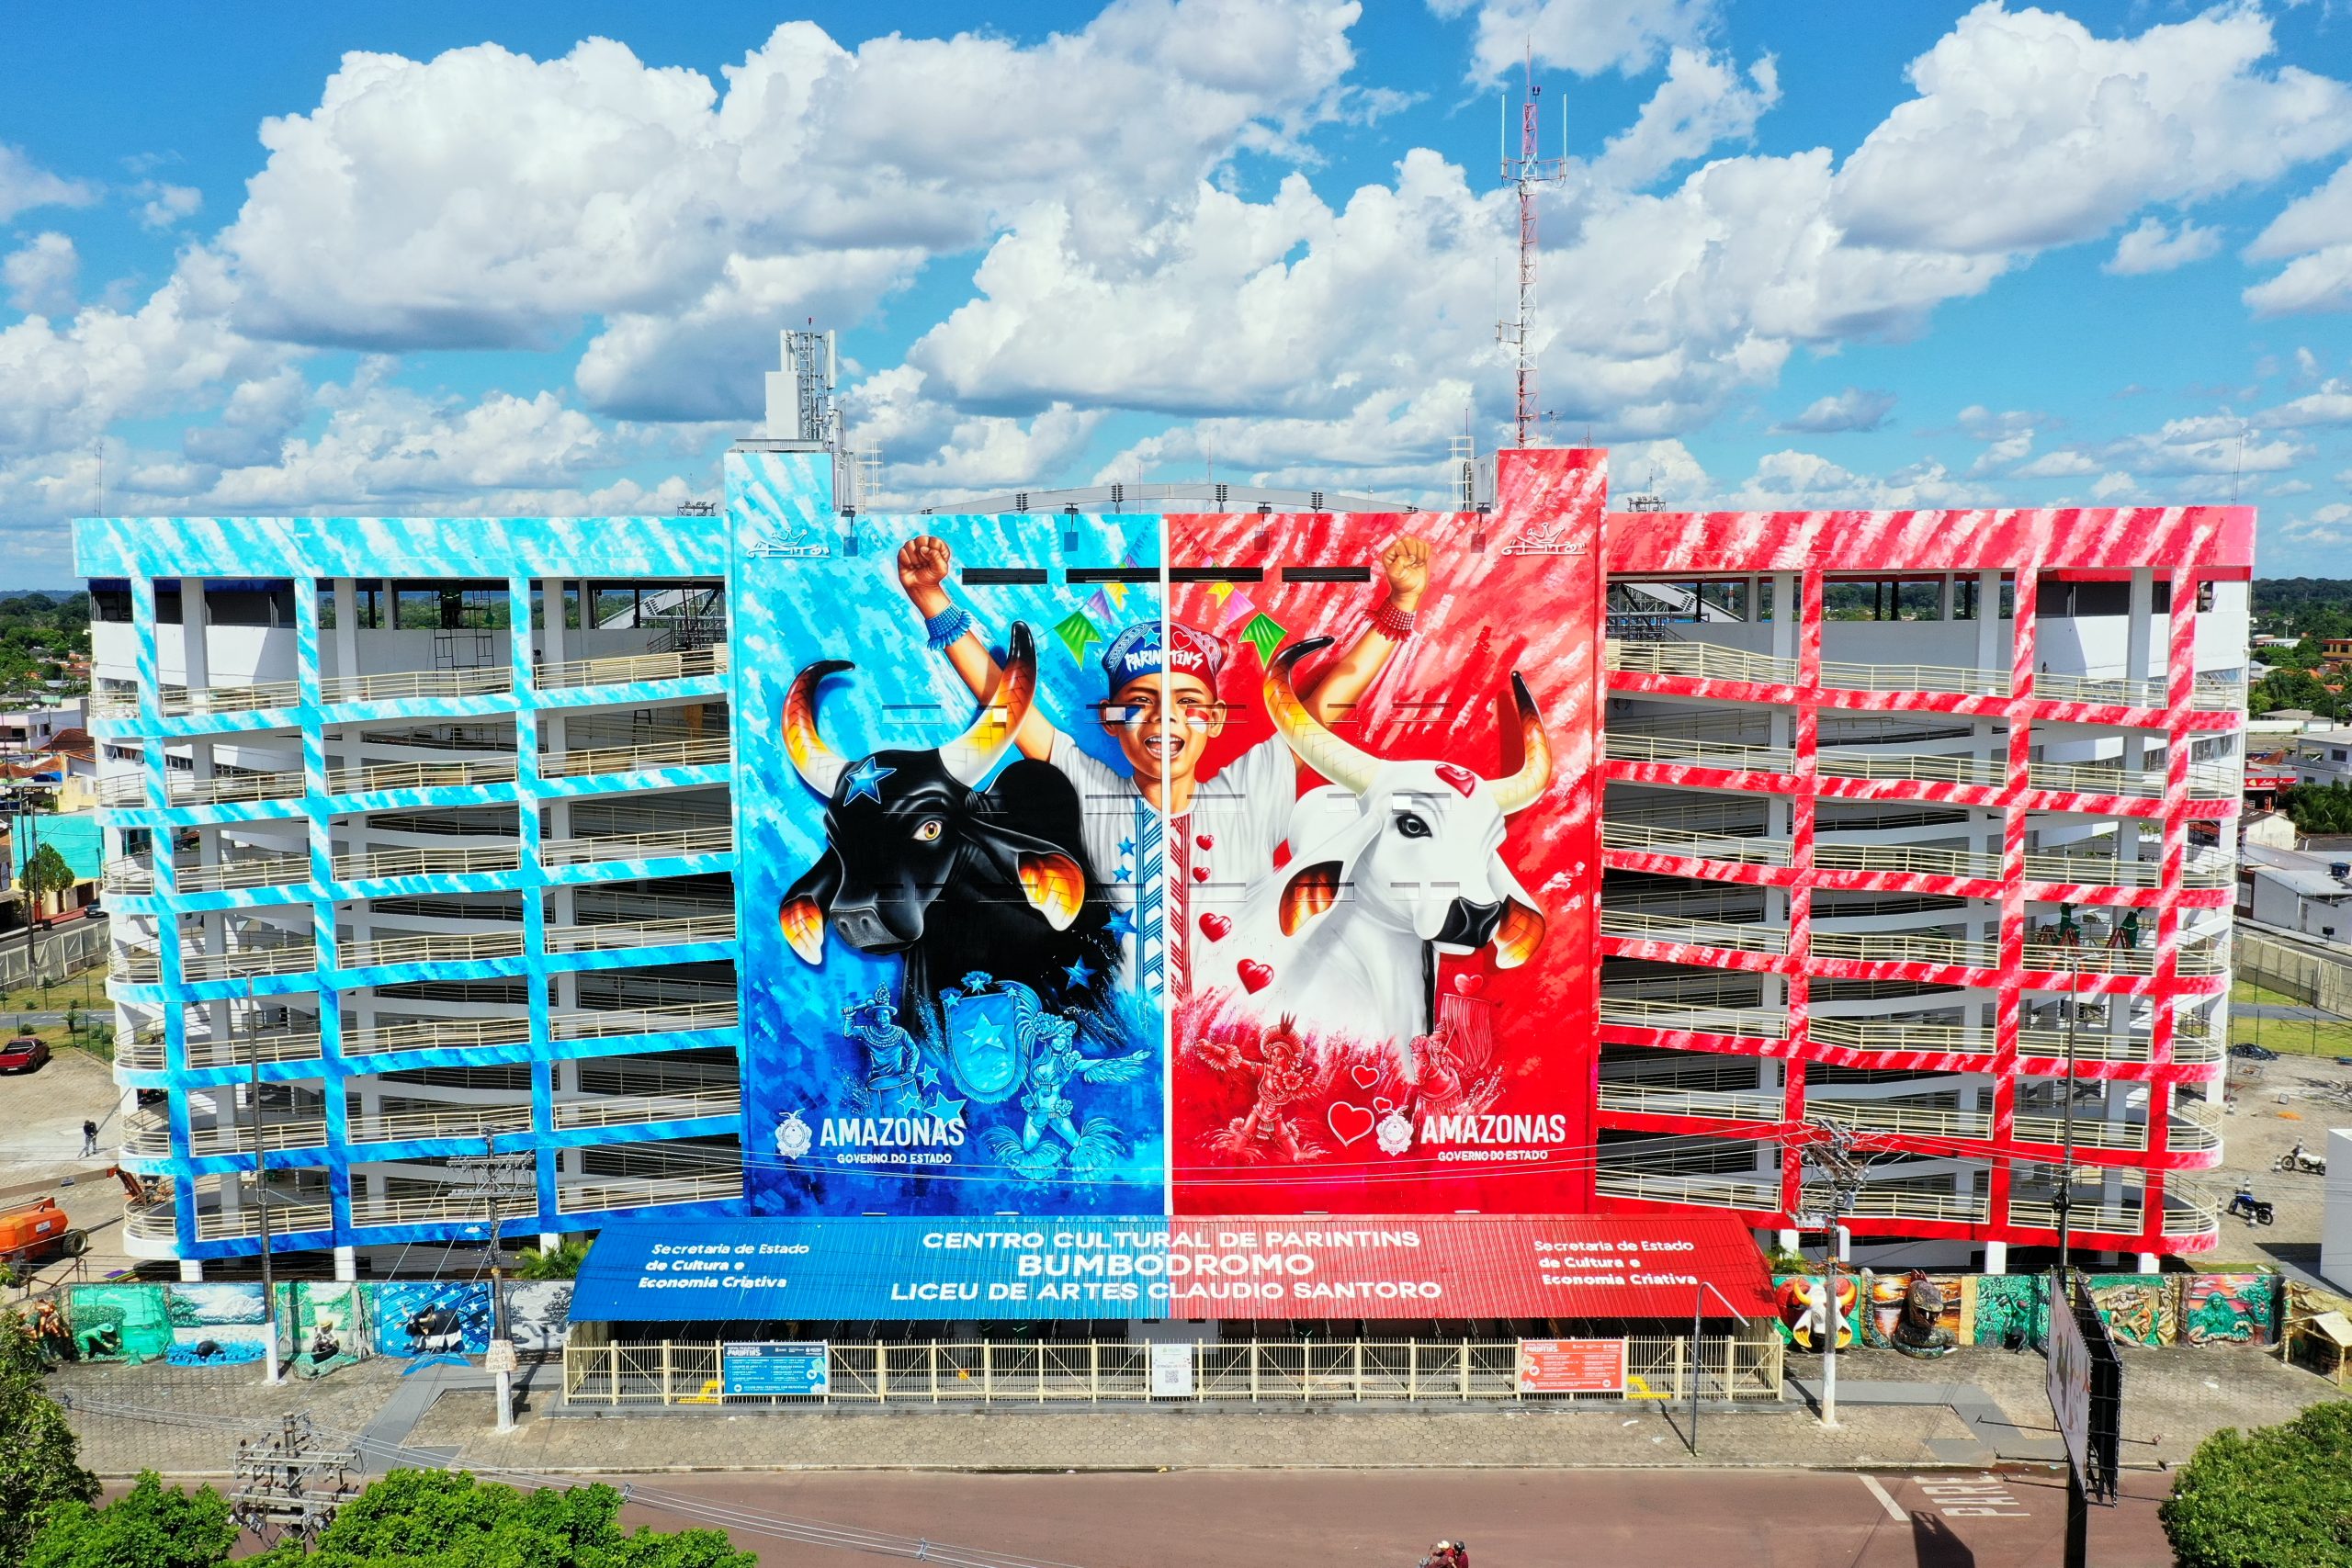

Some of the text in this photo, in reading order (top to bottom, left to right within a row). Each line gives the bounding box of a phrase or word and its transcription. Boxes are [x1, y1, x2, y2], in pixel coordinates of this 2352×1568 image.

[820, 1117, 965, 1147] AMAZONAS
[1420, 1114, 1566, 1145] AMAZONAS
[837, 1153, 952, 1164] GOVERNO DO ESTADO
[1438, 1149, 1549, 1162] GOVERNO DO ESTADO
[922, 1231, 1420, 1248] CENTRO CULTURAL DE PARINTINS
[1533, 1239, 1695, 1252] Secretaria de Estado
[650, 1243, 809, 1255] Secretaria de Estado
[645, 1259, 745, 1271] de Cultura e
[1538, 1257, 1642, 1269] de Cultura e
[638, 1275, 787, 1289] Economia Criativa
[1541, 1273, 1699, 1286] Economia Criativa
[890, 1281, 1442, 1300] LICEU DE ARTES CLAUDIO SANTORO
[1911, 1475, 2032, 1517] PARE
